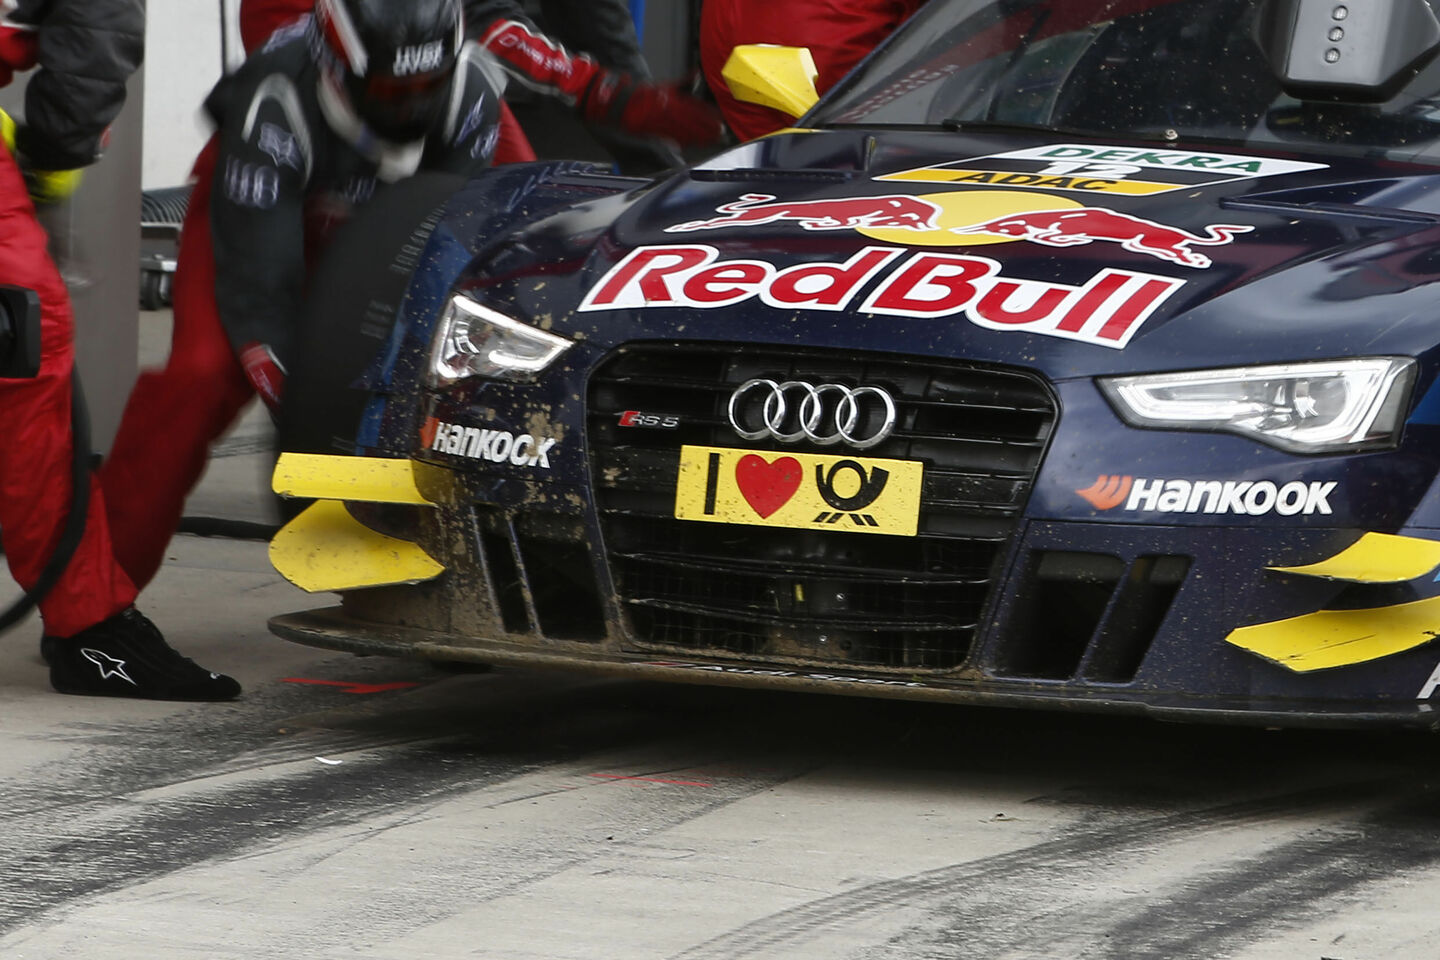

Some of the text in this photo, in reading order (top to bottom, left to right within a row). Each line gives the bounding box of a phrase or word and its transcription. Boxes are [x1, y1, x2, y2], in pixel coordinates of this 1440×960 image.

[1040, 161, 1143, 181] 12
[1048, 147, 1263, 174] DEKRA
[958, 171, 1120, 191] ADAC
[578, 245, 1187, 350] Red Bull
